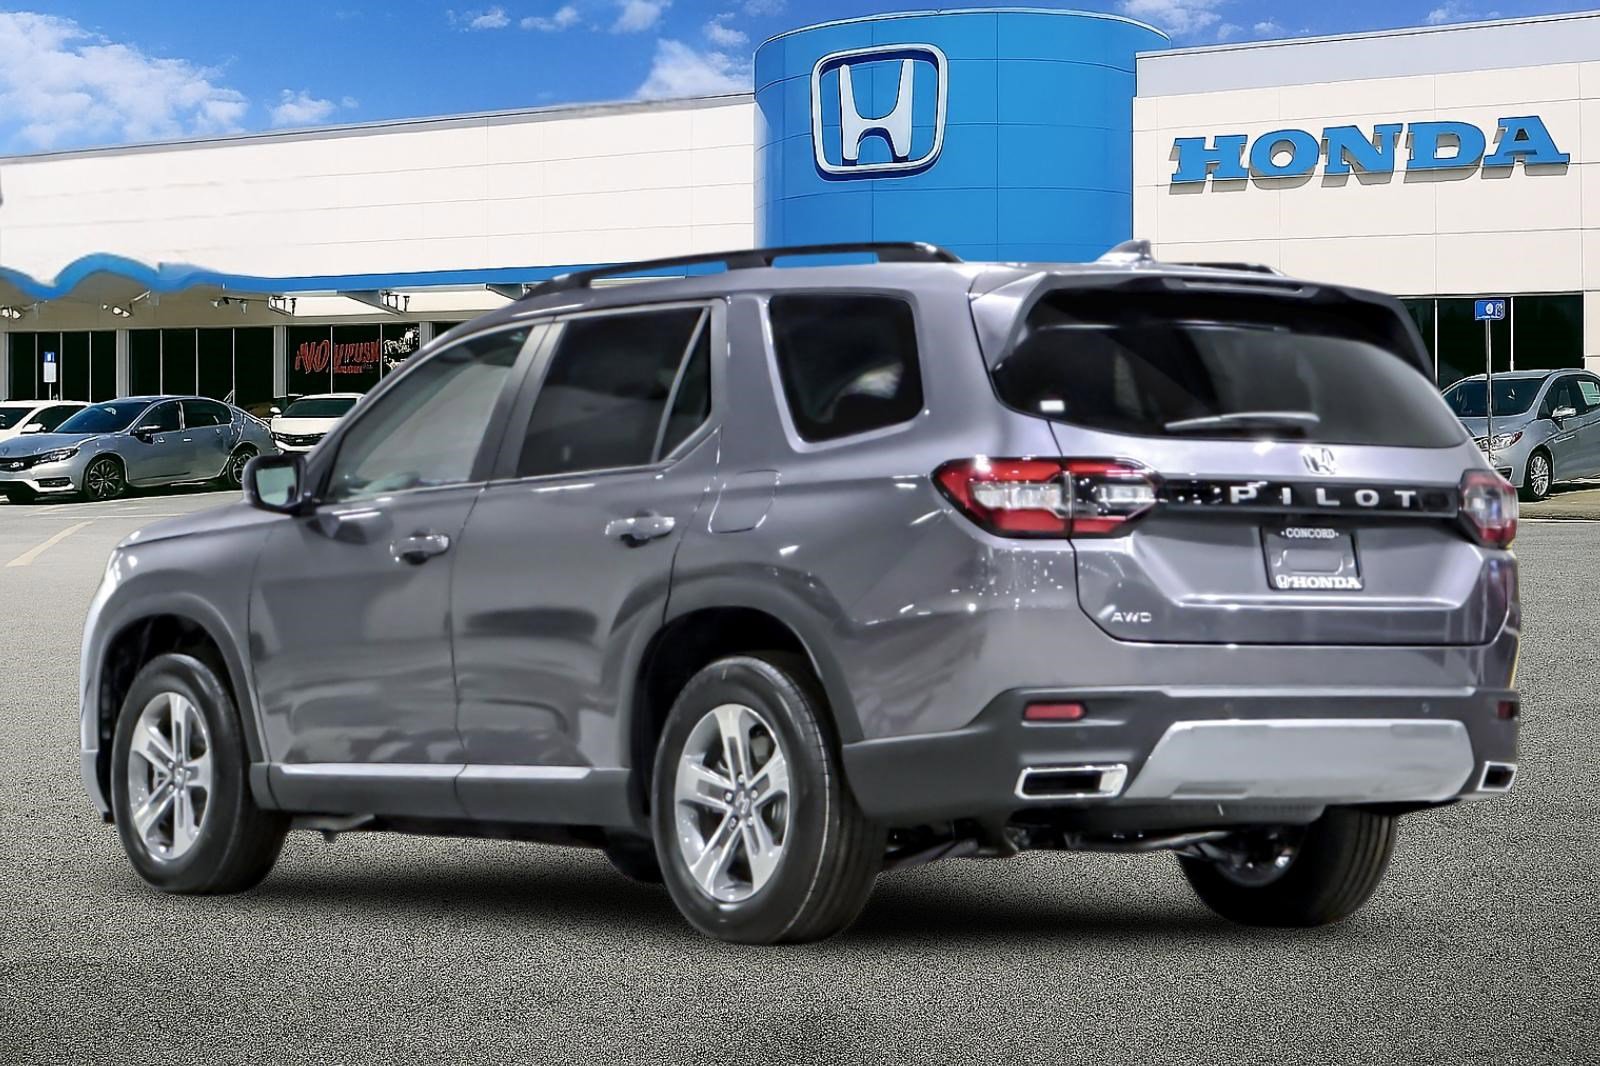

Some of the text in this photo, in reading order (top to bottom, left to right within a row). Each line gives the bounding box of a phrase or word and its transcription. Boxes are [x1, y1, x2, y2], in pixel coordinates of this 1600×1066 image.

[1170, 115, 1570, 188] HONDA
[1230, 485, 1416, 508] PILOT
[1285, 527, 1336, 538] CONCORD
[1289, 575, 1362, 589] HONDA
[1111, 611, 1152, 623] AWD
